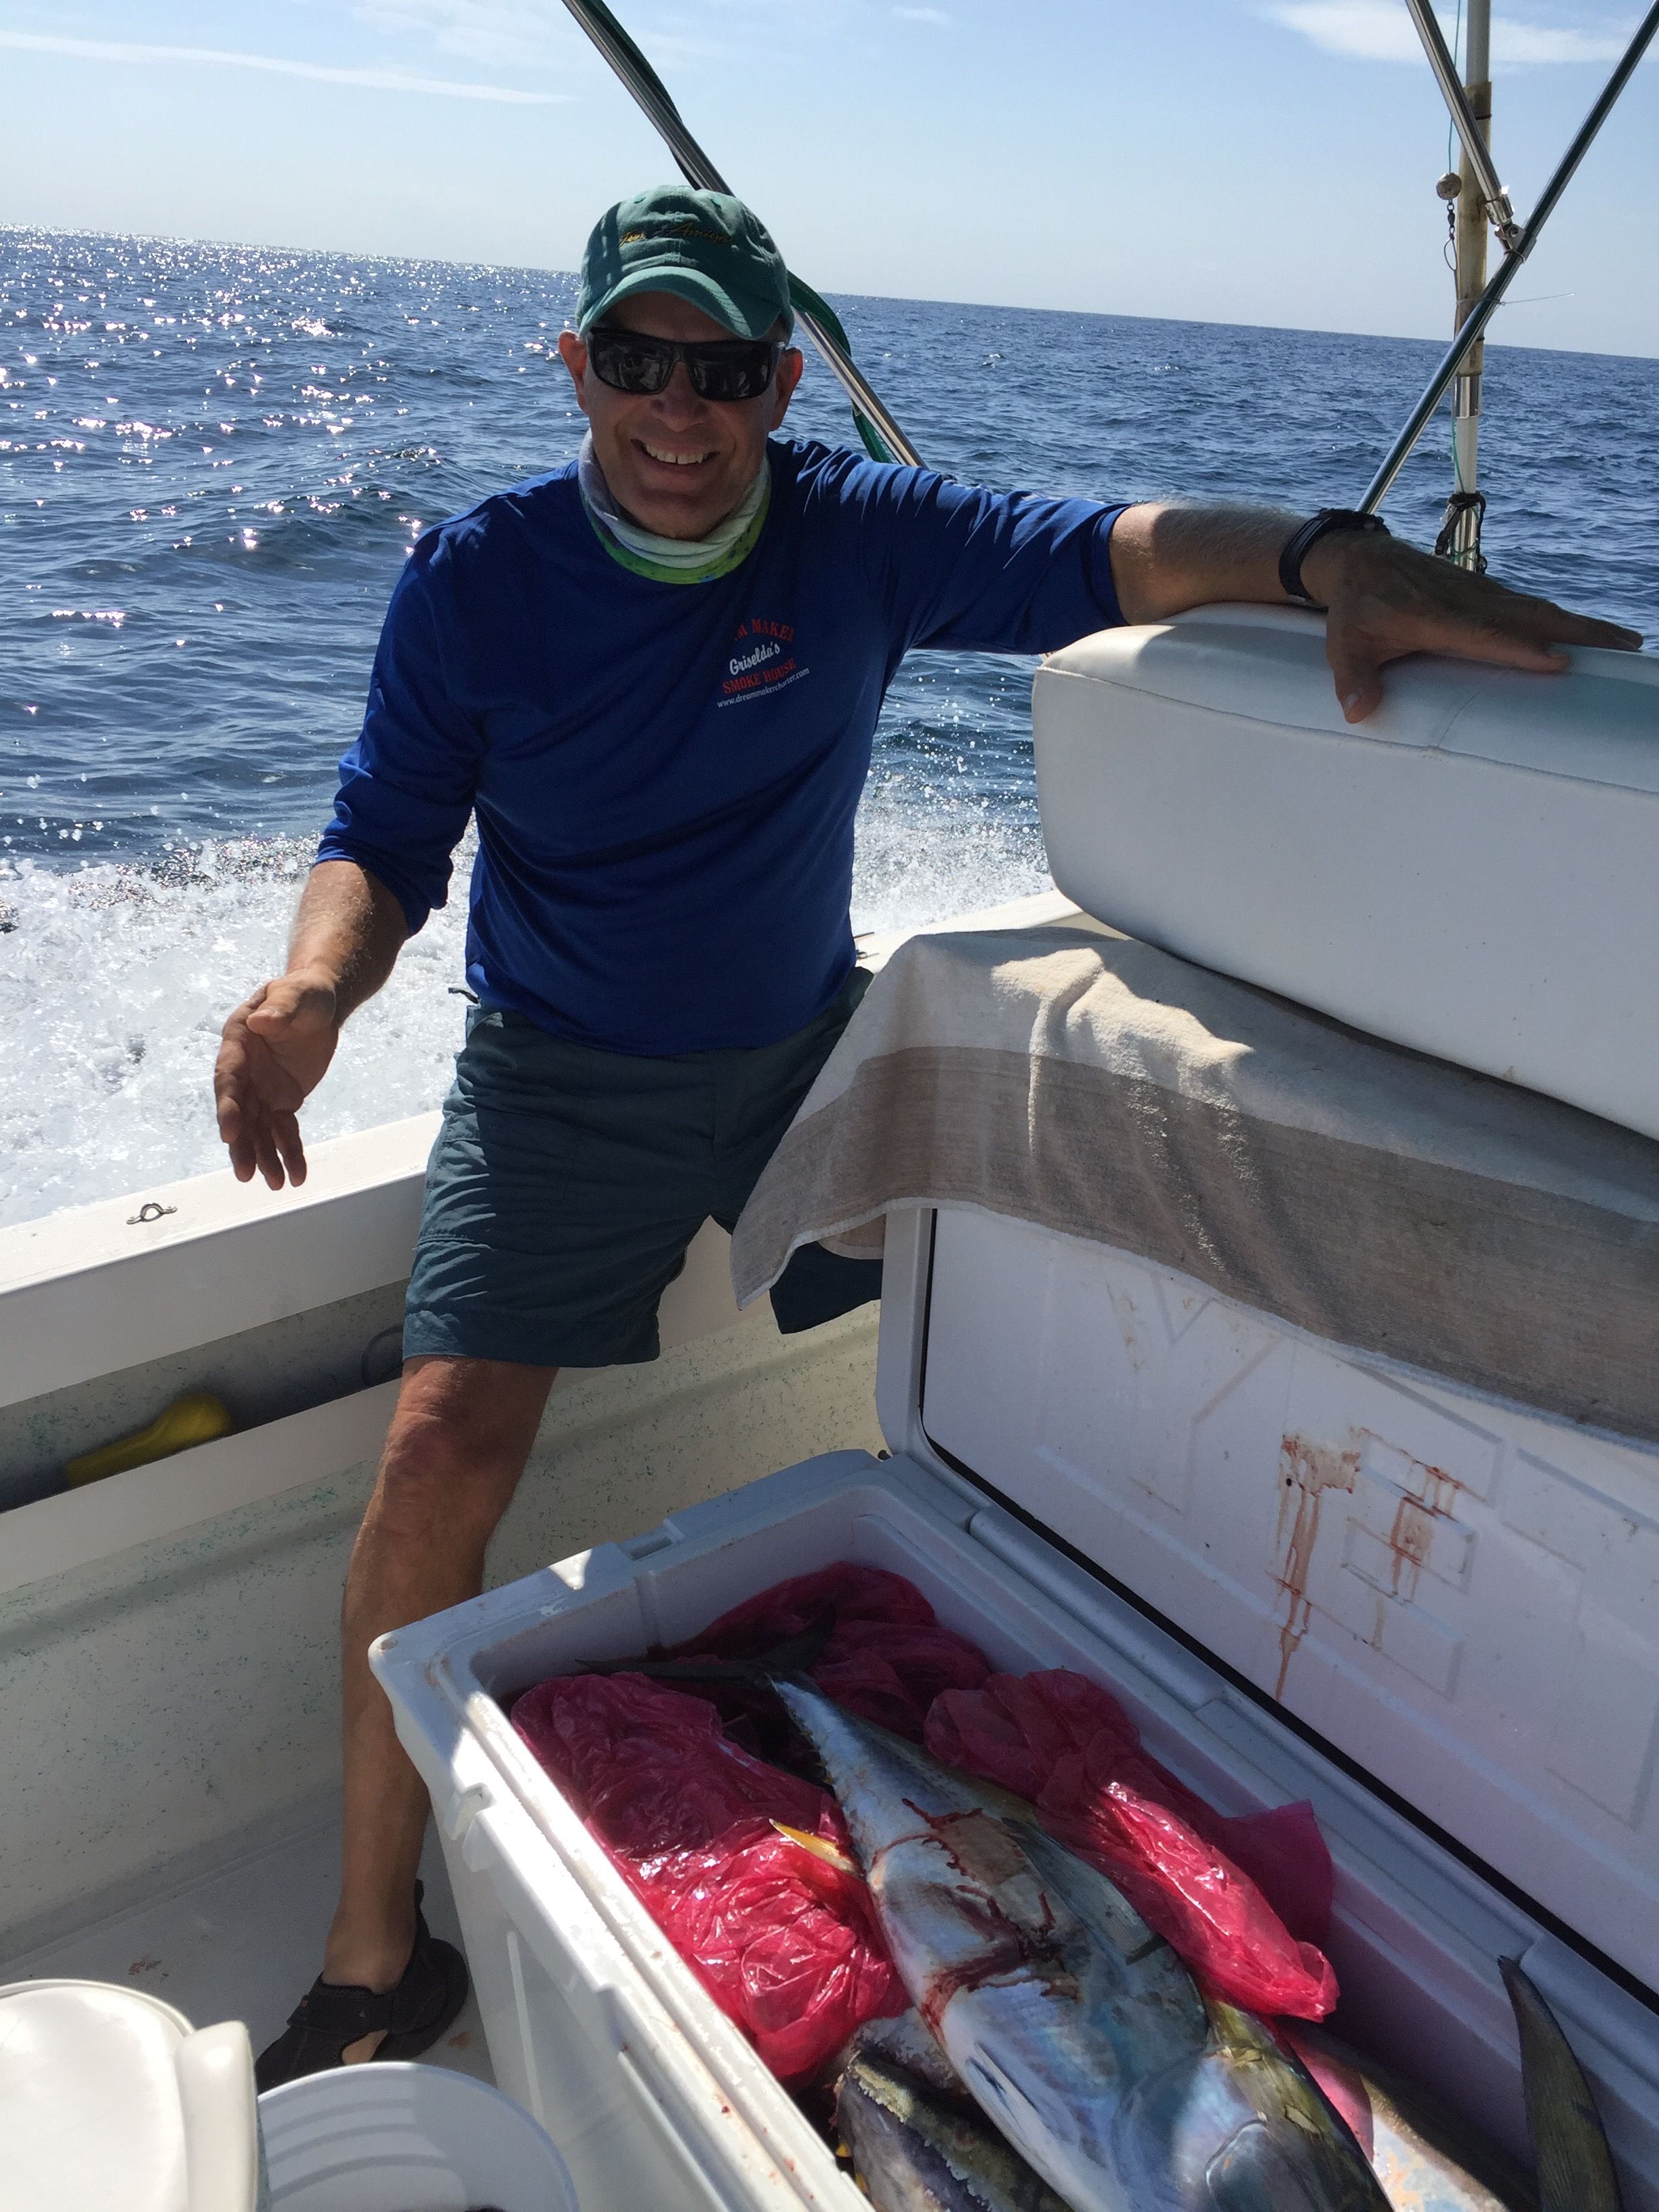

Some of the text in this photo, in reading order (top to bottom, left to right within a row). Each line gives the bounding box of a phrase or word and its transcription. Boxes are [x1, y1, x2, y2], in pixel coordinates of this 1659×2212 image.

[722, 657, 797, 695] SMOKE HOUSE
[729, 641, 781, 676] Griselda's
[716, 668, 811, 708] www.dreammakercharter.com
